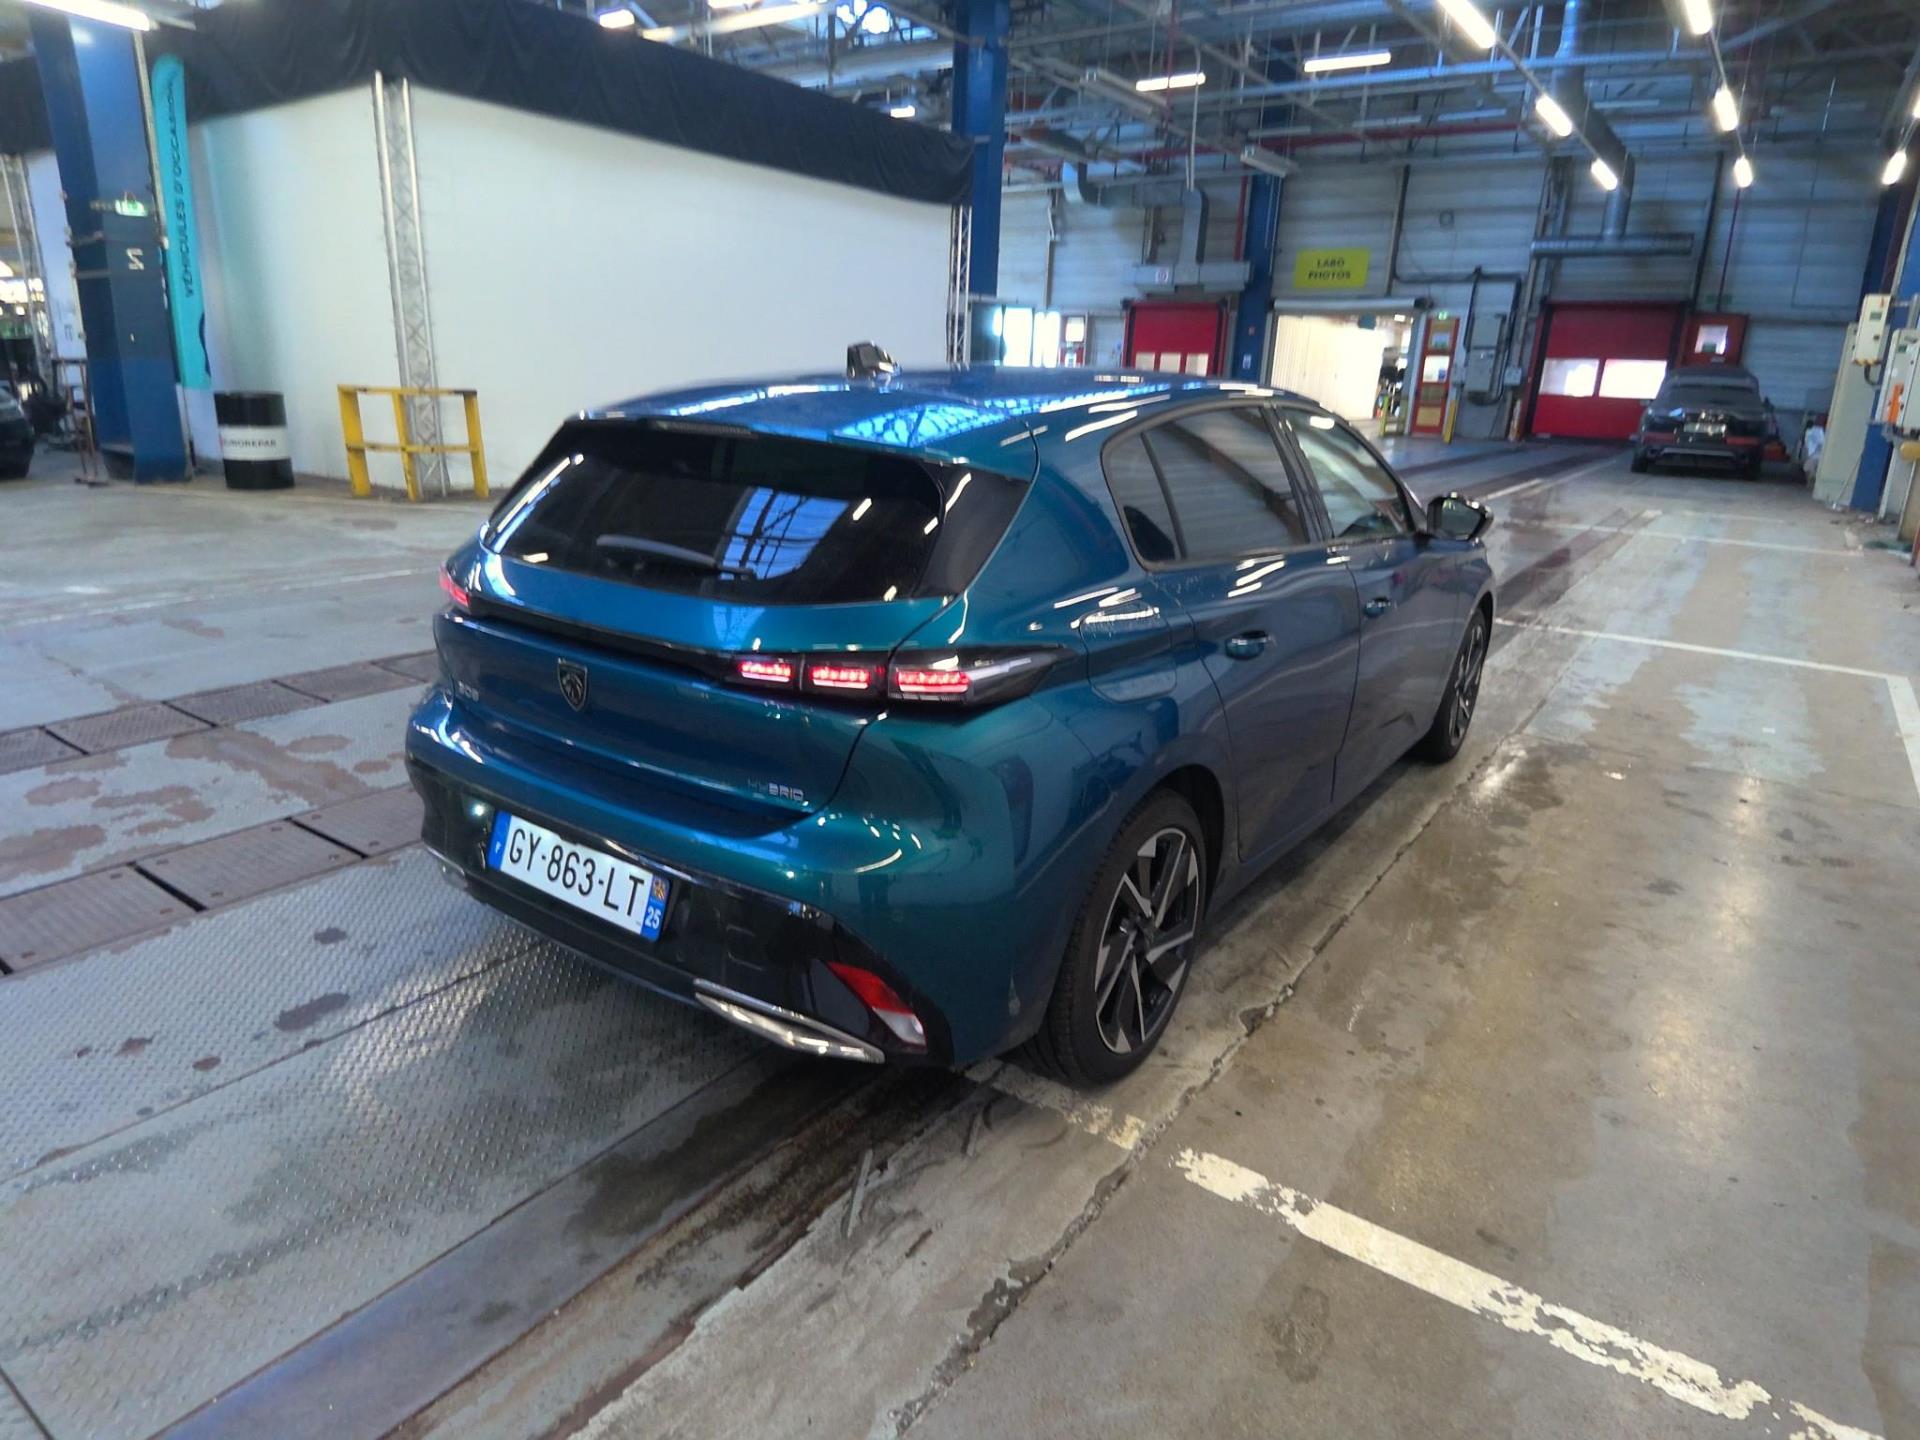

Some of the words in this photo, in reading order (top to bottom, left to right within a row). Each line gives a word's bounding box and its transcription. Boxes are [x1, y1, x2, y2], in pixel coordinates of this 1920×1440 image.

[1317, 256, 1345, 269] LABO
[1308, 270, 1352, 280] PHOTOS
[509, 828, 645, 917] GY-863-LT
[645, 906, 662, 928] 25
